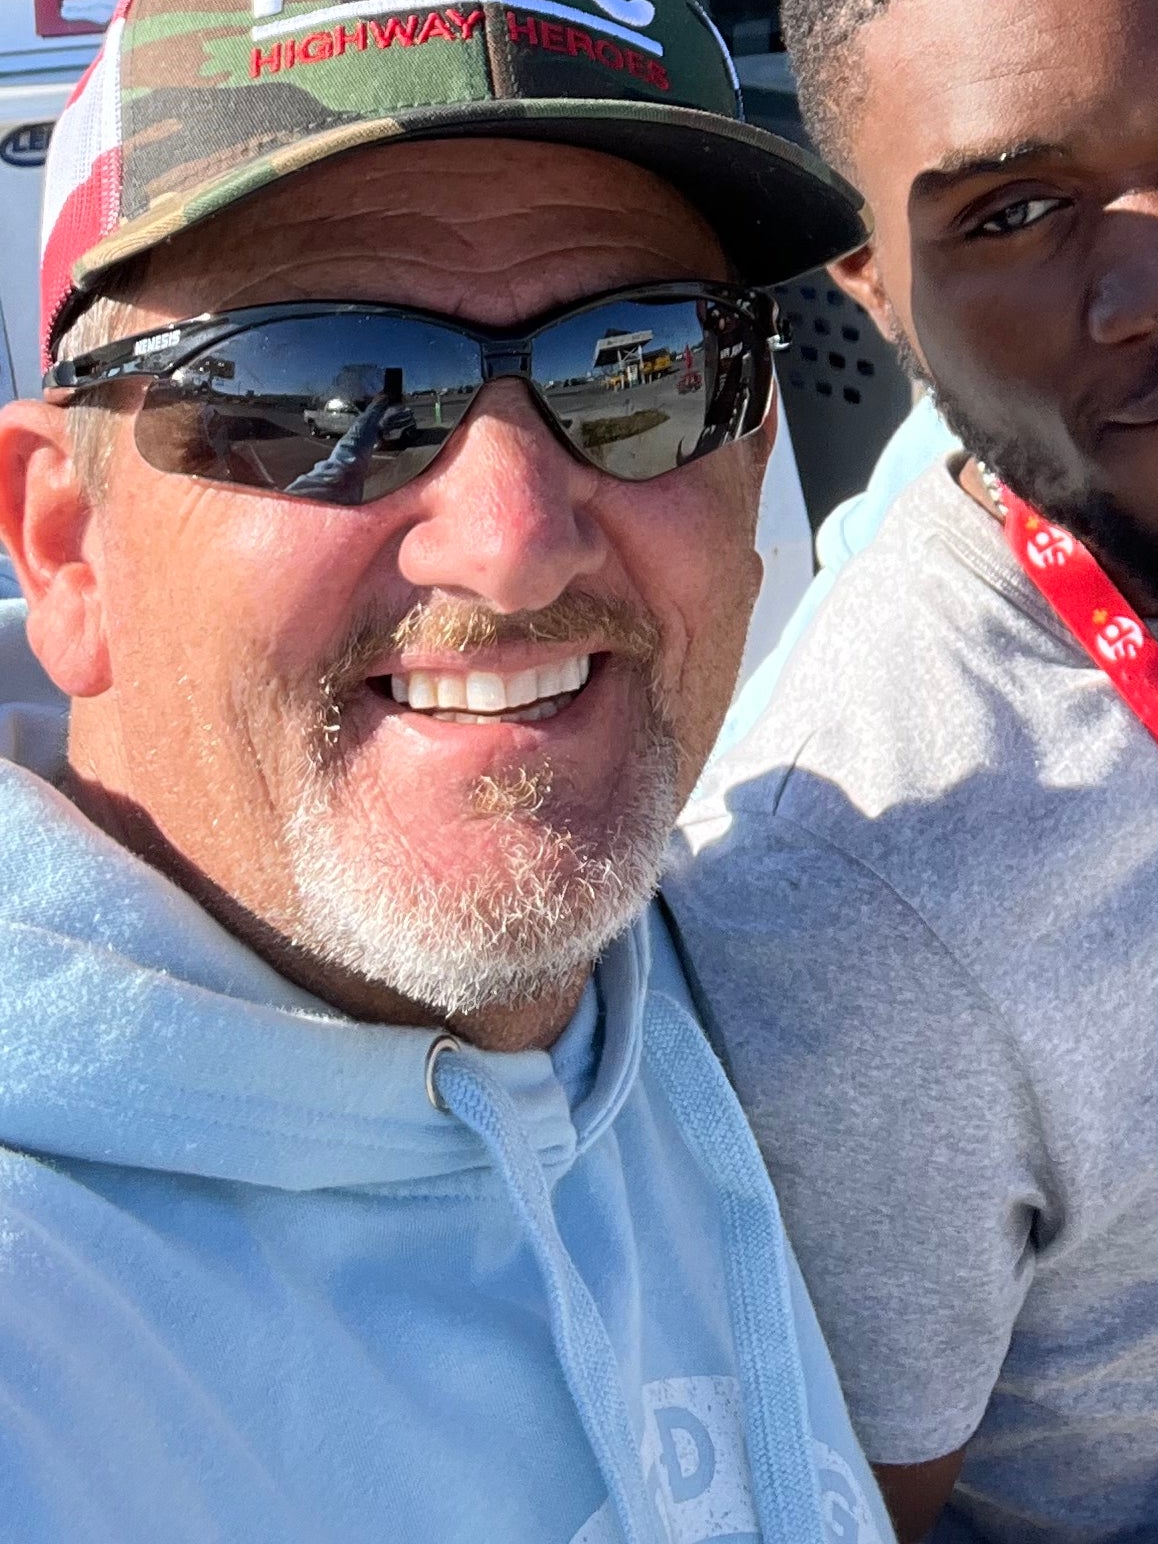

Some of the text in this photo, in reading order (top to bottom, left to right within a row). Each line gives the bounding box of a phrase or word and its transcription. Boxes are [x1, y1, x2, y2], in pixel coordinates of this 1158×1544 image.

[248, 8, 672, 91] HIGHWAY HEROES
[134, 329, 181, 356] NEMESIS
